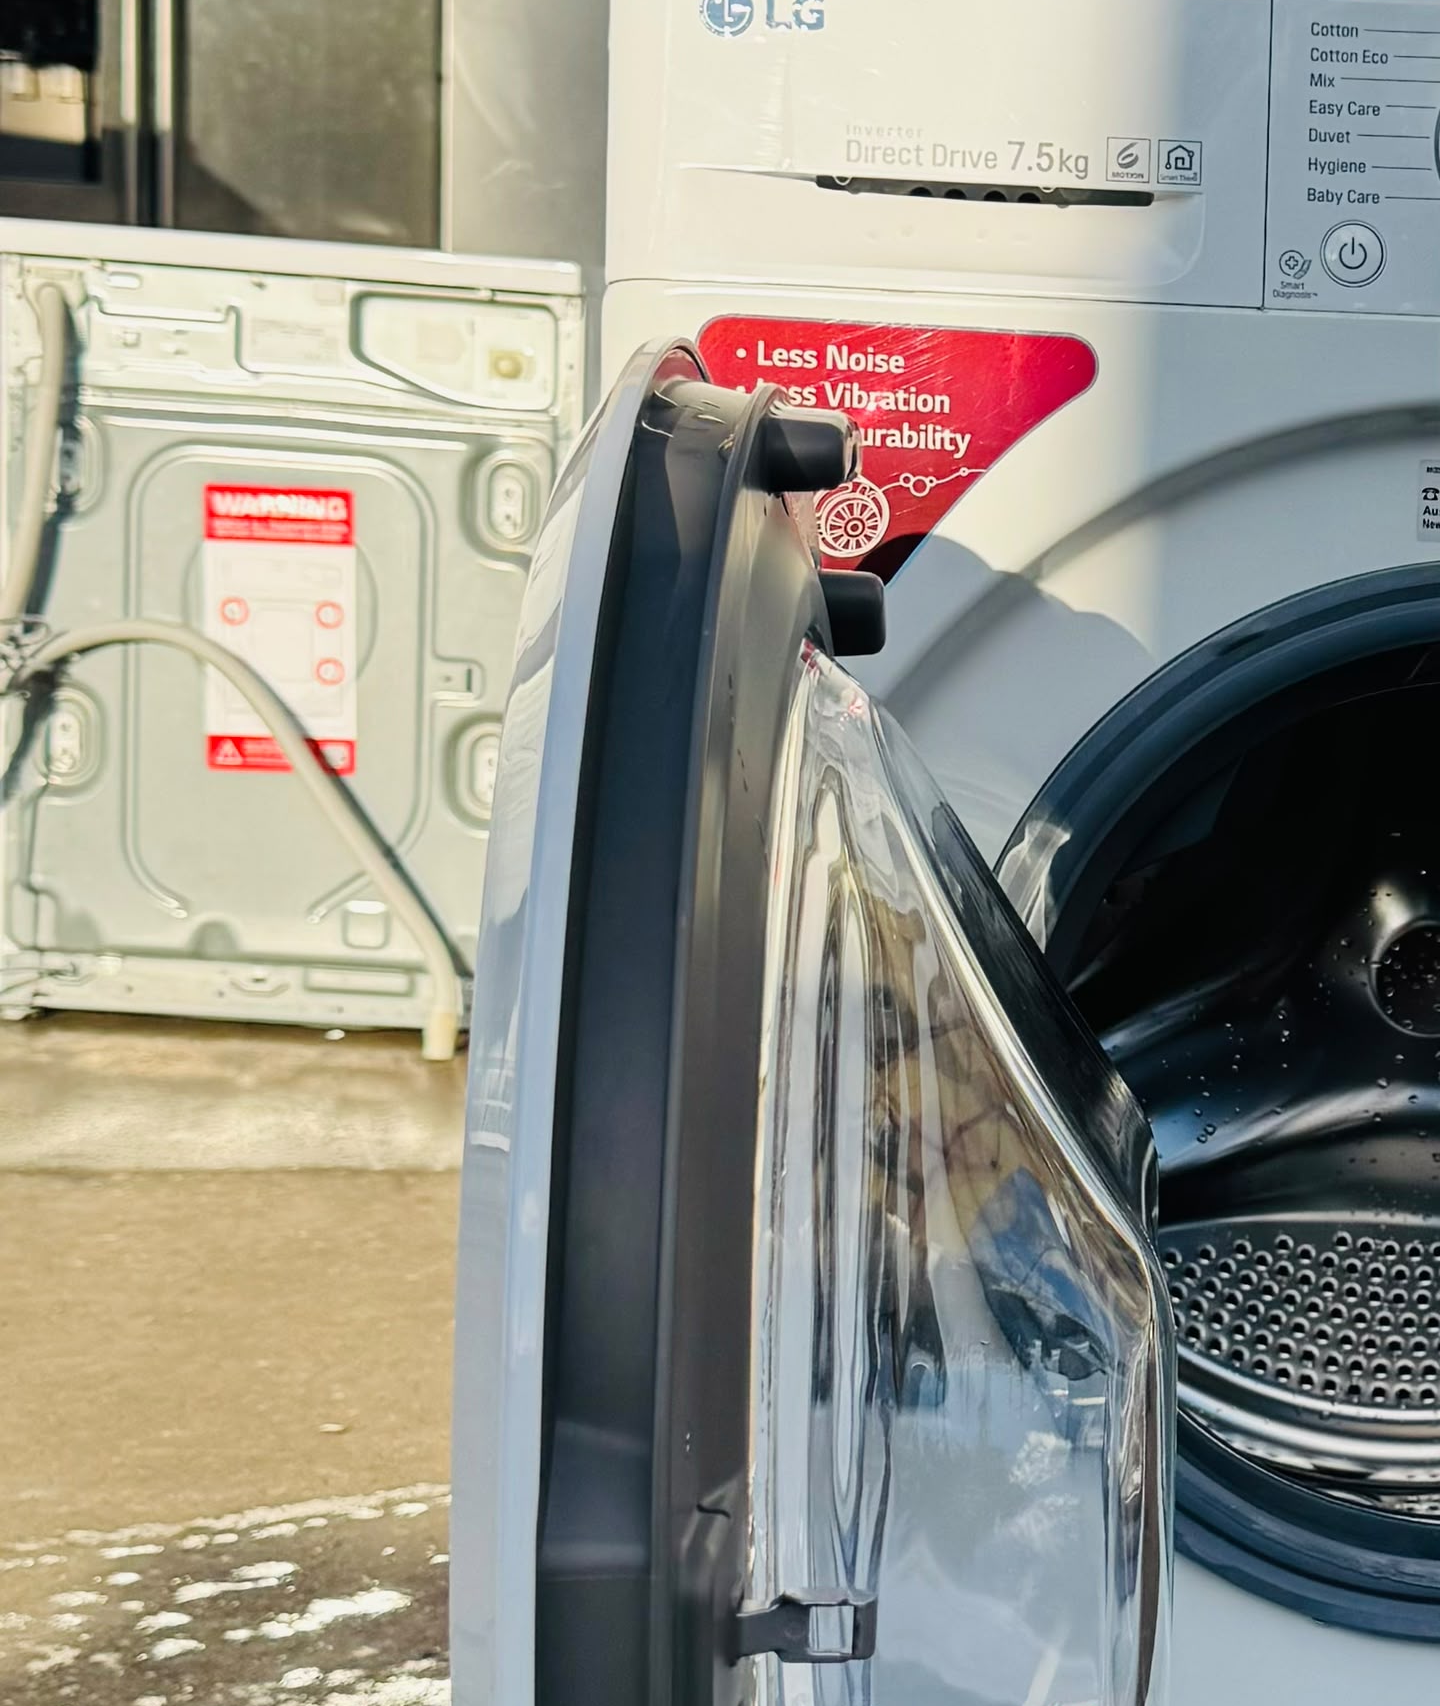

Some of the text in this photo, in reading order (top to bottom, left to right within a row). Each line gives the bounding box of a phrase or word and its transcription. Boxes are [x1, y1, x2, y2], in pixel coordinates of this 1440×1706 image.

[1311, 22, 1359, 38] Cotton
[1310, 48, 1389, 65] Cotton Eco
[1310, 73, 1335, 88] Mix
[1309, 100, 1381, 119] Easy Care
[1309, 129, 1351, 144] Duvet
[846, 139, 923, 166] Direct
[932, 143, 998, 170] Drive
[1308, 157, 1367, 176] Hygiene
[1307, 188, 1380, 206] Baby Care
[757, 340, 905, 374] Less Noise
[824, 382, 950, 414] Vibration
[861, 423, 971, 459] urability
